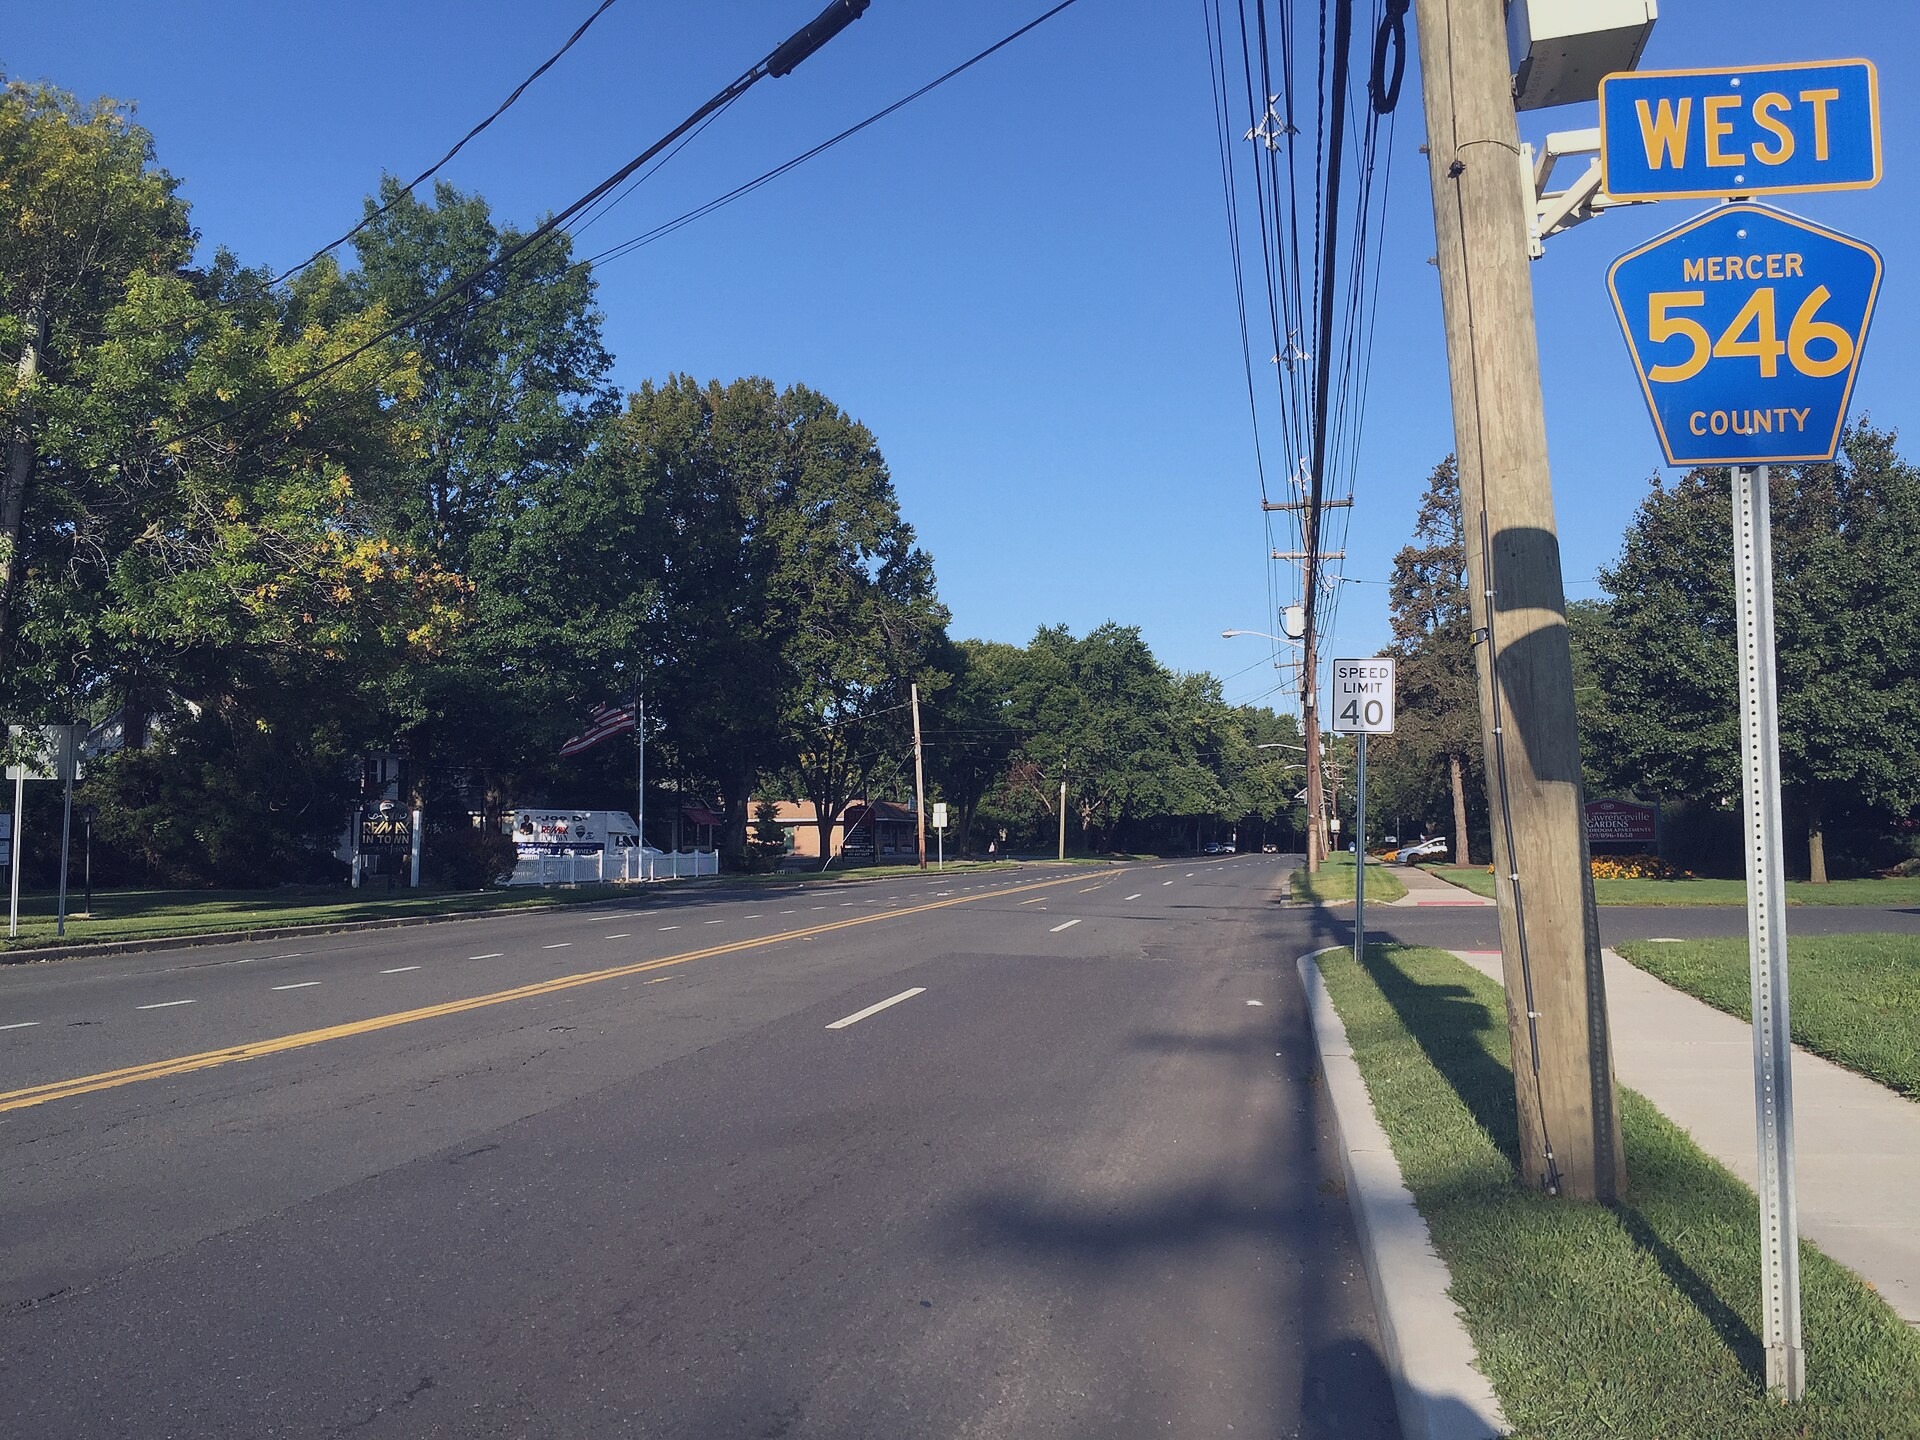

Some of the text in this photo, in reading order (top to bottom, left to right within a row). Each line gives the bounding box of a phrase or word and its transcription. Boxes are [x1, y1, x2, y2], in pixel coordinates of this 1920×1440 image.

[1634, 88, 1839, 170] WEST
[1683, 253, 1804, 282] MERCER
[1647, 284, 1854, 383] 546
[1689, 407, 1811, 435] COUNTY
[1338, 667, 1389, 679] SPEED
[1343, 682, 1382, 693] LIMIT
[1340, 699, 1383, 726] 40
[1586, 811, 1650, 822] Lawrenceville
[1586, 820, 1629, 828] GARDENS
[362, 835, 410, 844] IN TOWN
